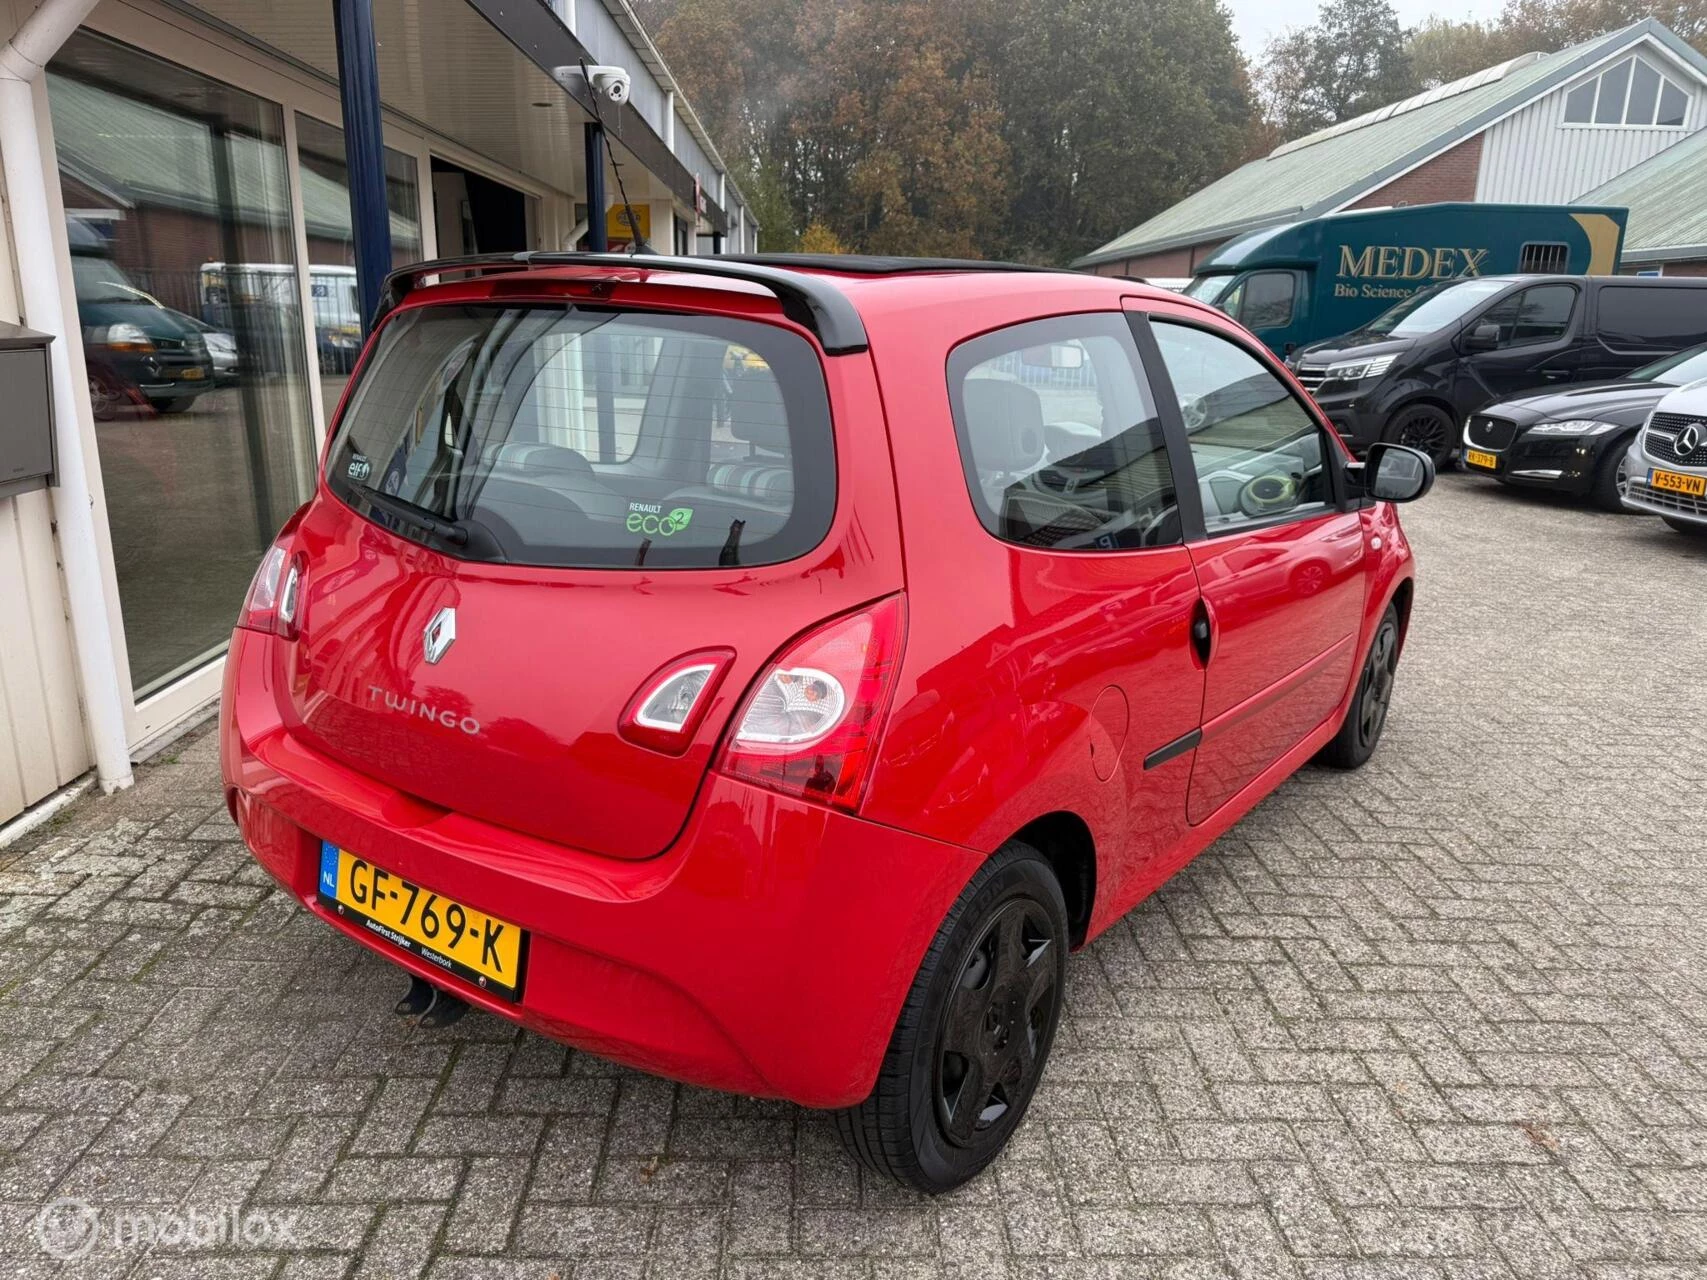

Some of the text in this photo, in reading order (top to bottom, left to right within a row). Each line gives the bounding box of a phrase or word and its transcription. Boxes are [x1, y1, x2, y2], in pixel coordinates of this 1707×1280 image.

[1336, 245, 1489, 280] MEDEX
[1334, 283, 1358, 297] Bio
[1655, 472, 1701, 492] V-553-VN
[629, 502, 662, 513] RENAULT
[368, 685, 480, 735] TWINGO
[322, 871, 335, 888] NL
[350, 859, 504, 973] GF-769-K
[366, 919, 391, 938] AutoFirst
[421, 946, 453, 969] Westerbork
